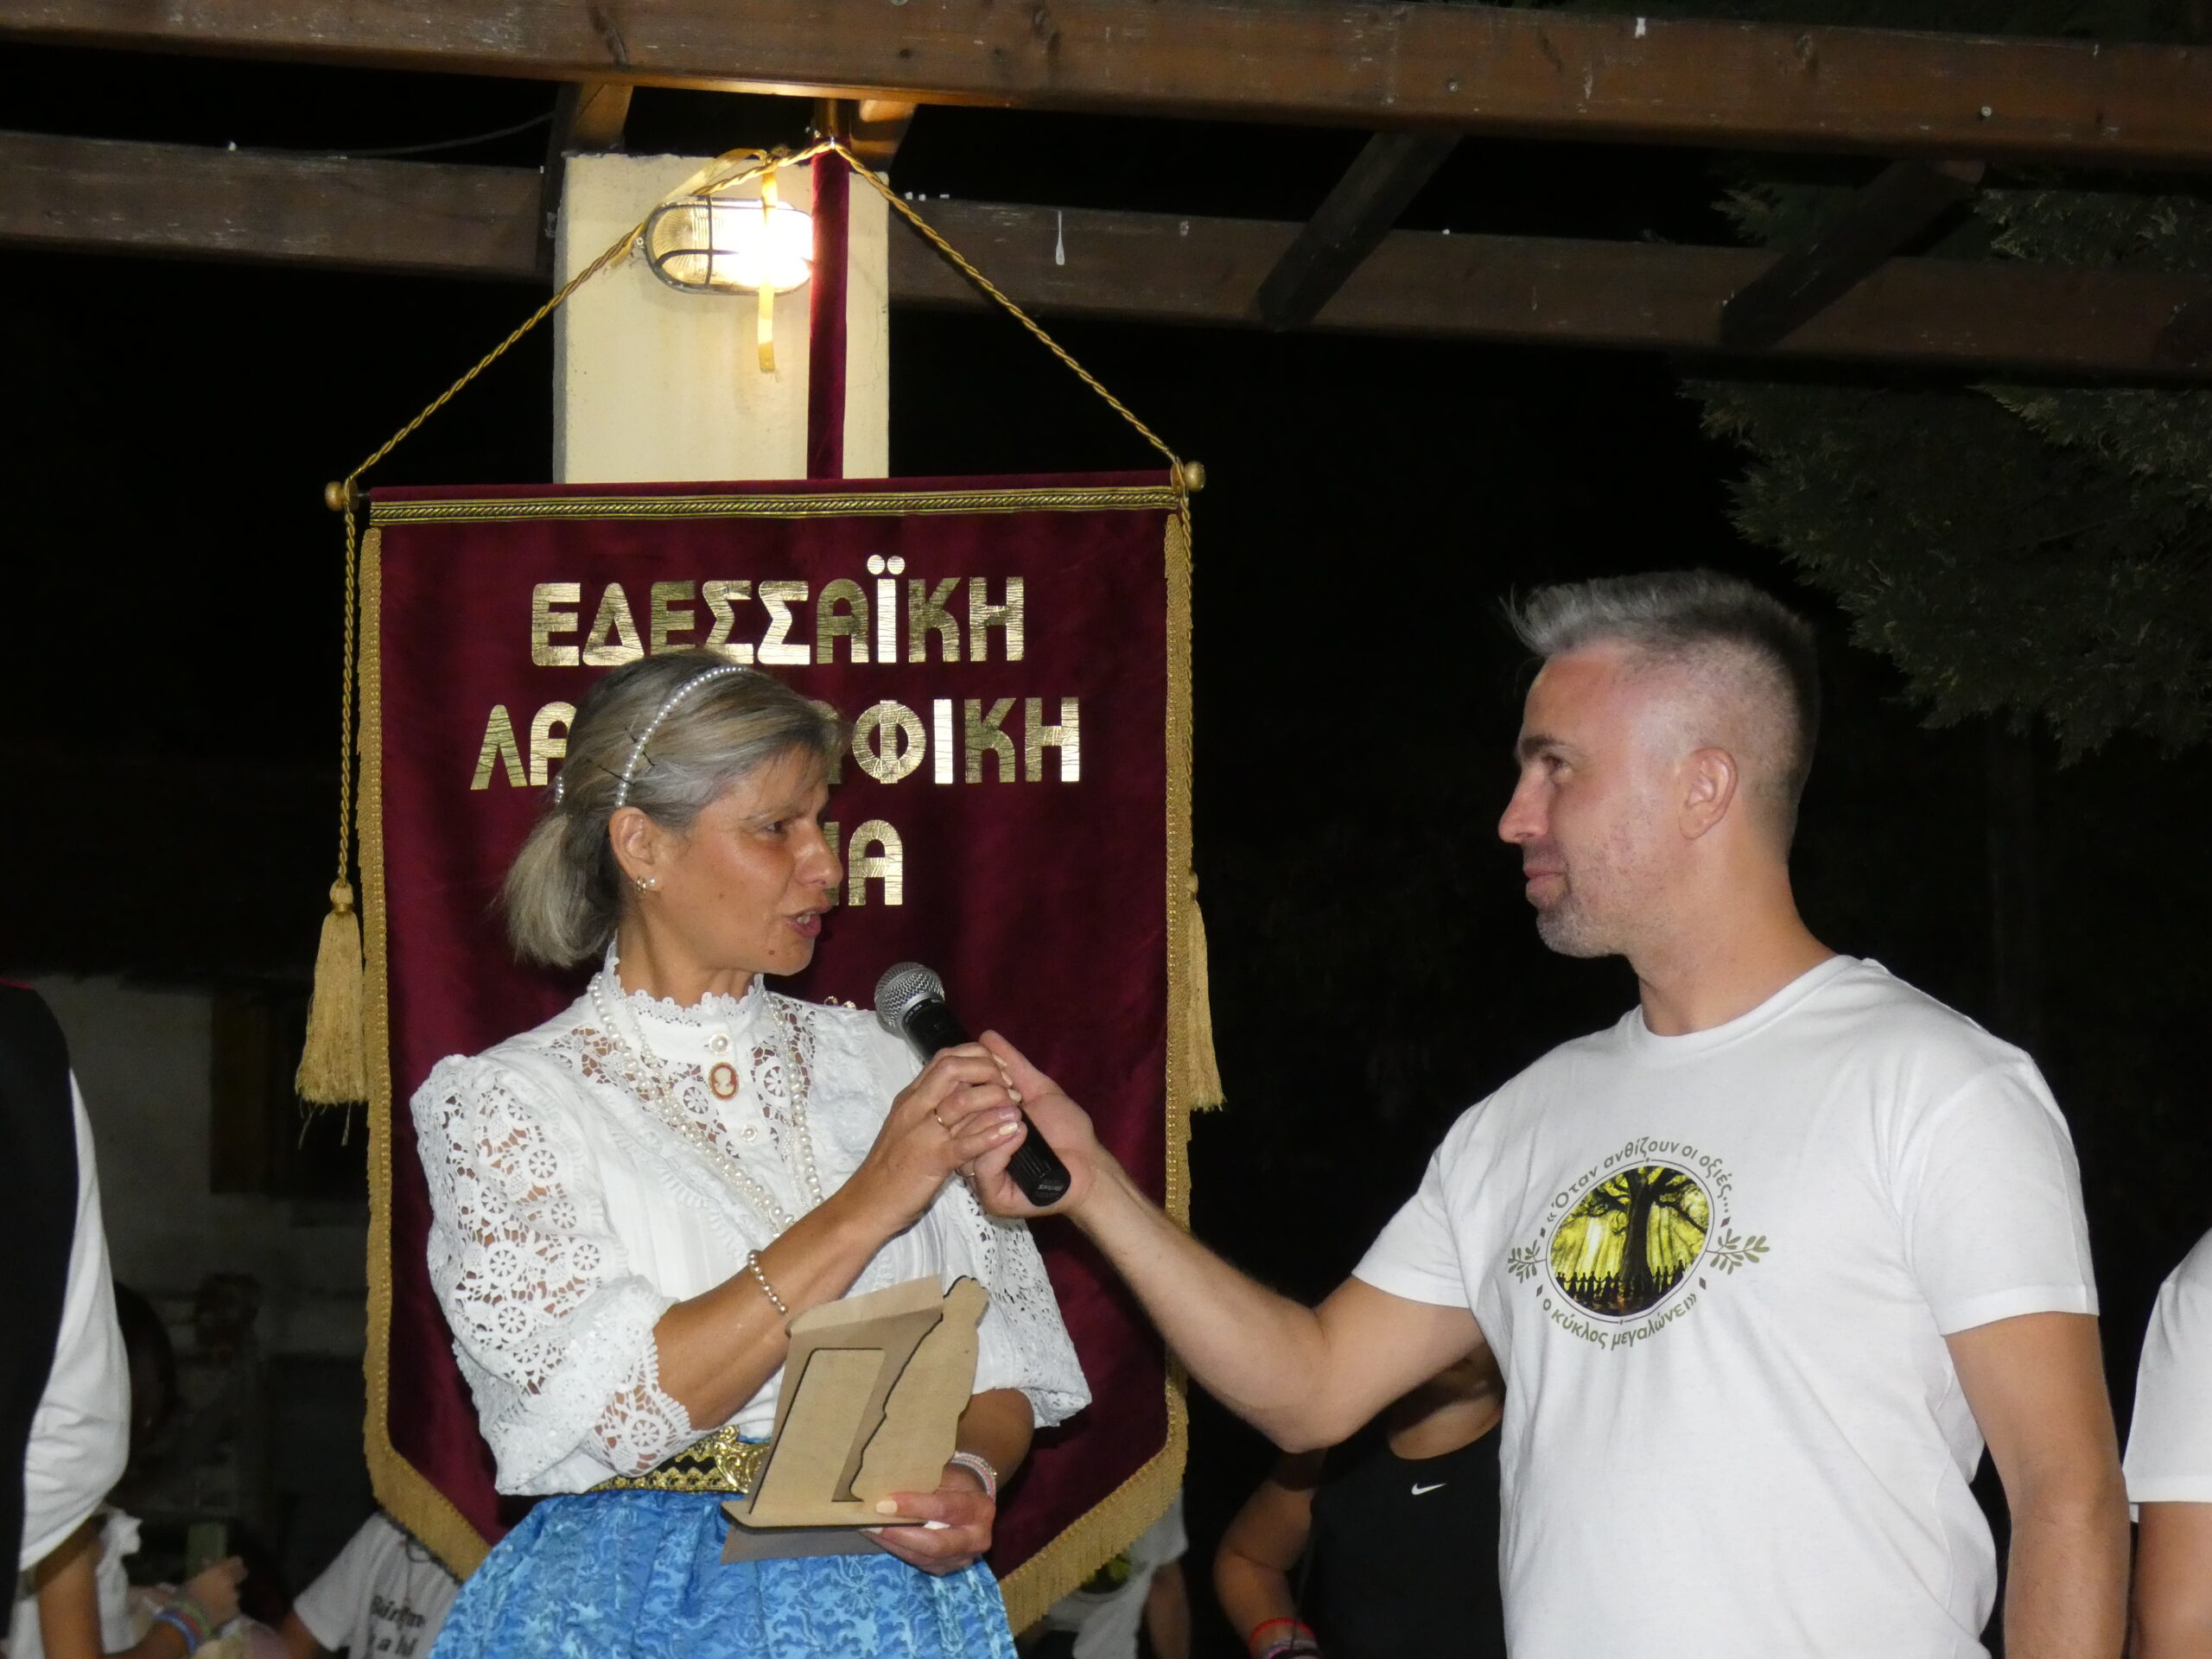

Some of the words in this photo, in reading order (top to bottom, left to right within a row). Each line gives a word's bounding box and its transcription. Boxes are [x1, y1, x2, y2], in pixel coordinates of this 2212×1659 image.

[531, 555, 1025, 666] ΕΔΕΣΣΑΪΚΗ
[470, 696, 1080, 790] ΛΑΦΙΚΗ
[1604, 1135, 1681, 1169] ανθίζουν
[1681, 1145, 1699, 1160] οι
[1542, 1298, 1552, 1311] ο
[1551, 1309, 1609, 1350] κύκλος
